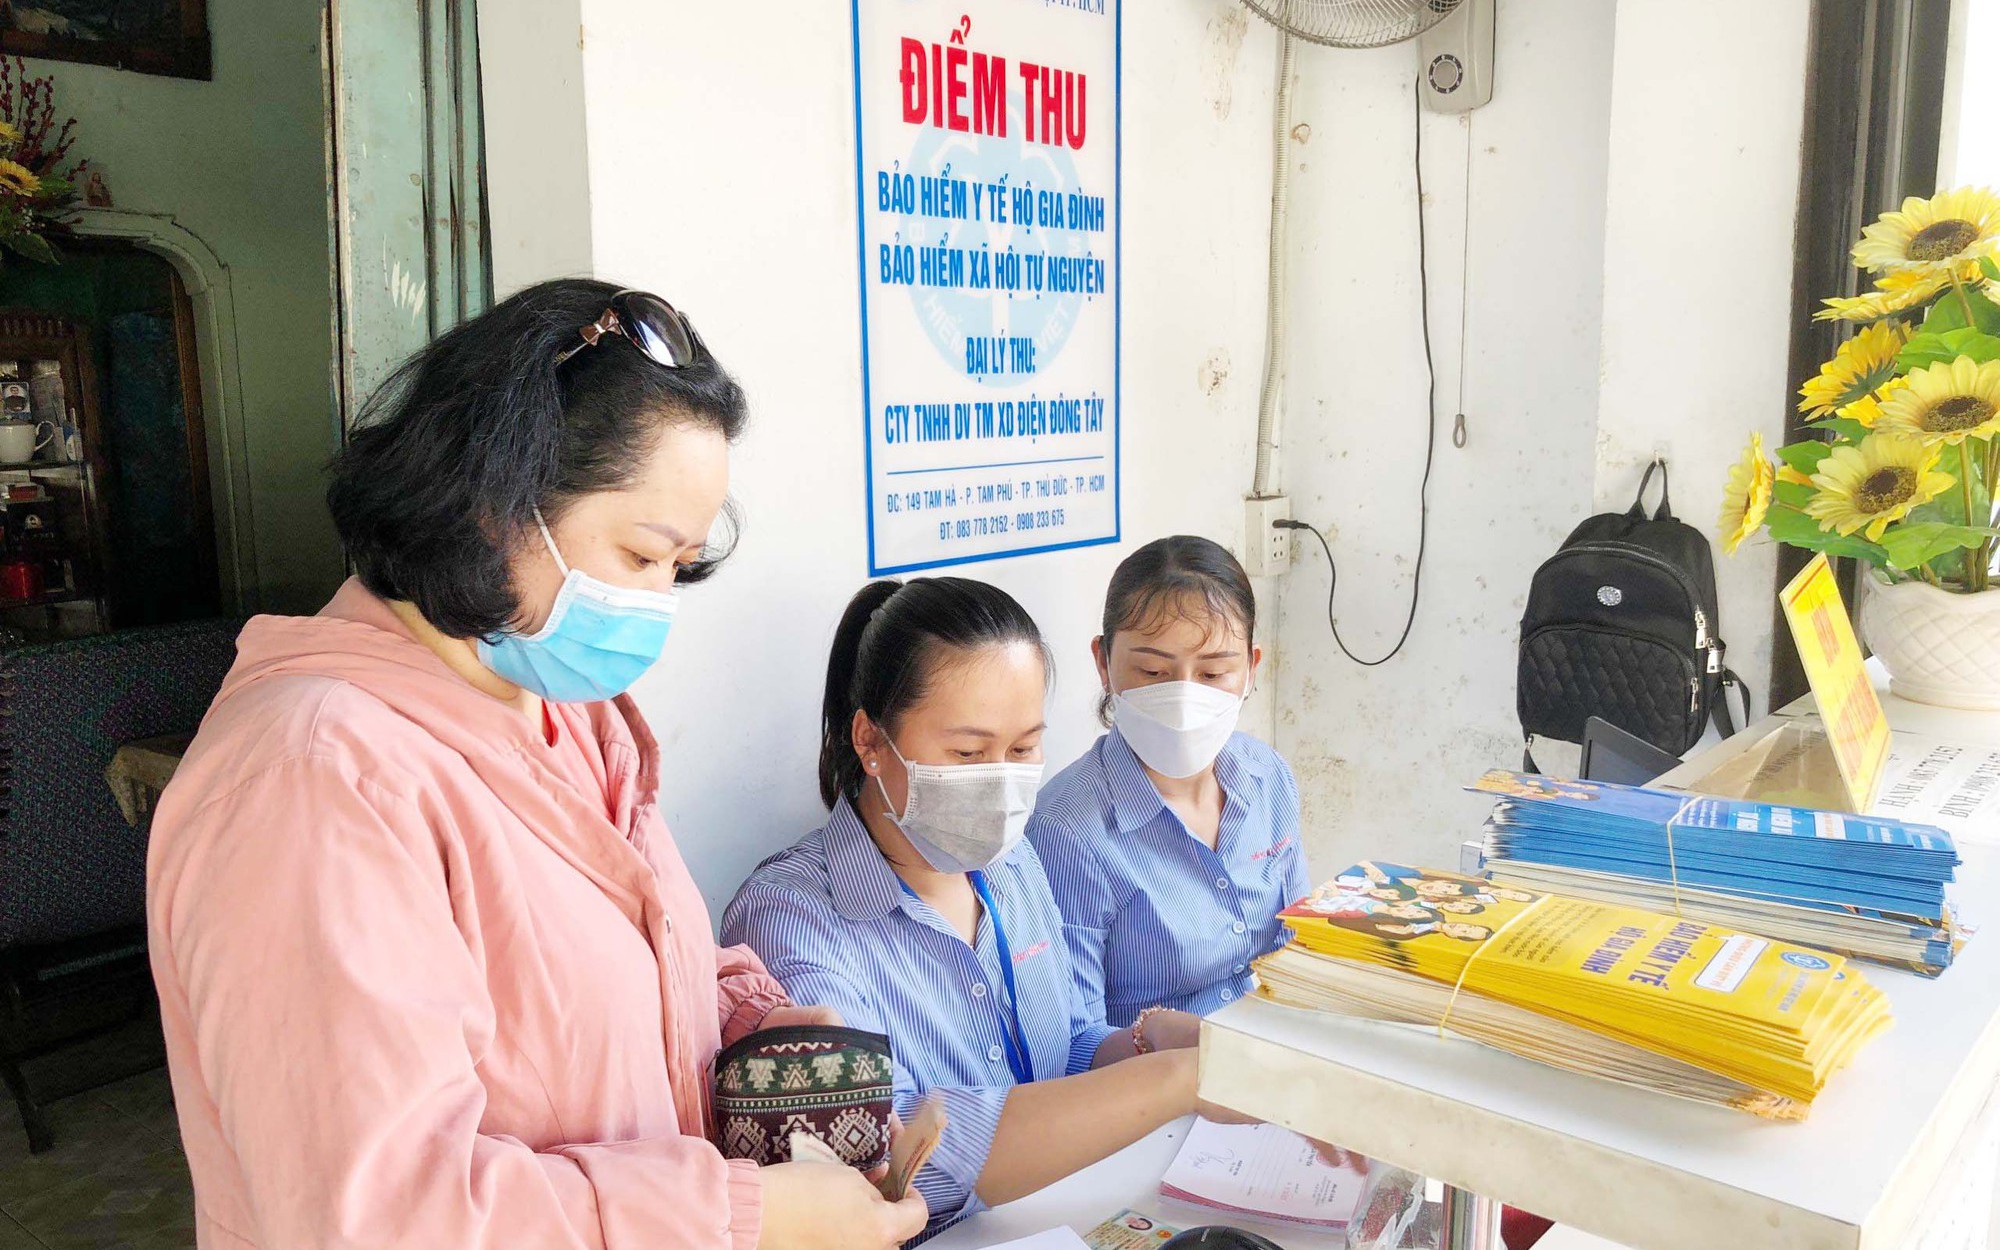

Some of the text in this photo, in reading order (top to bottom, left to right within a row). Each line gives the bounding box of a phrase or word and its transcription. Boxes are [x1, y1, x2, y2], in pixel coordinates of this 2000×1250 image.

[899, 14, 1086, 150] ĐIỂM THU
[878, 160, 1105, 234] BẢO HIỂM Y TẾ HỘ GIA ĐÌNH
[880, 231, 1105, 301] BẢO HIỂM XÃ HỘI TỰ NGUYỆN
[966, 329, 1036, 383] ĐẠI LÝ THU:
[885, 391, 1105, 444] CTY TNHH DV TM XD ĐIỆN ĐÔNG TÂY
[887, 493, 903, 513] ĐC:
[905, 493, 921, 511] 149
[924, 490, 942, 509] TAM
[945, 486, 957, 507] HÀ
[966, 487, 975, 504] P.
[977, 485, 994, 504] TAM
[997, 478, 1013, 502] PHÚ
[1021, 481, 1034, 500] TP.
[1036, 474, 1051, 498] THỦ
[1052, 475, 1068, 496] ĐỨC
[1075, 477, 1087, 495] TP.
[1089, 474, 1105, 493] HCM
[940, 522, 954, 541] ĐT:
[956, 520, 971, 539] 083
[974, 518, 988, 537] 778
[990, 515, 1009, 535] 2152
[1016, 512, 1035, 531] 0908
[1036, 510, 1050, 529] 233
[1052, 509, 1065, 526] 675
[1580, 948, 1625, 975] ĐÌNH
[1600, 936, 1636, 955] GIA
[1647, 937, 1696, 964] HIỂM
[1628, 969, 1669, 991] TẾ
